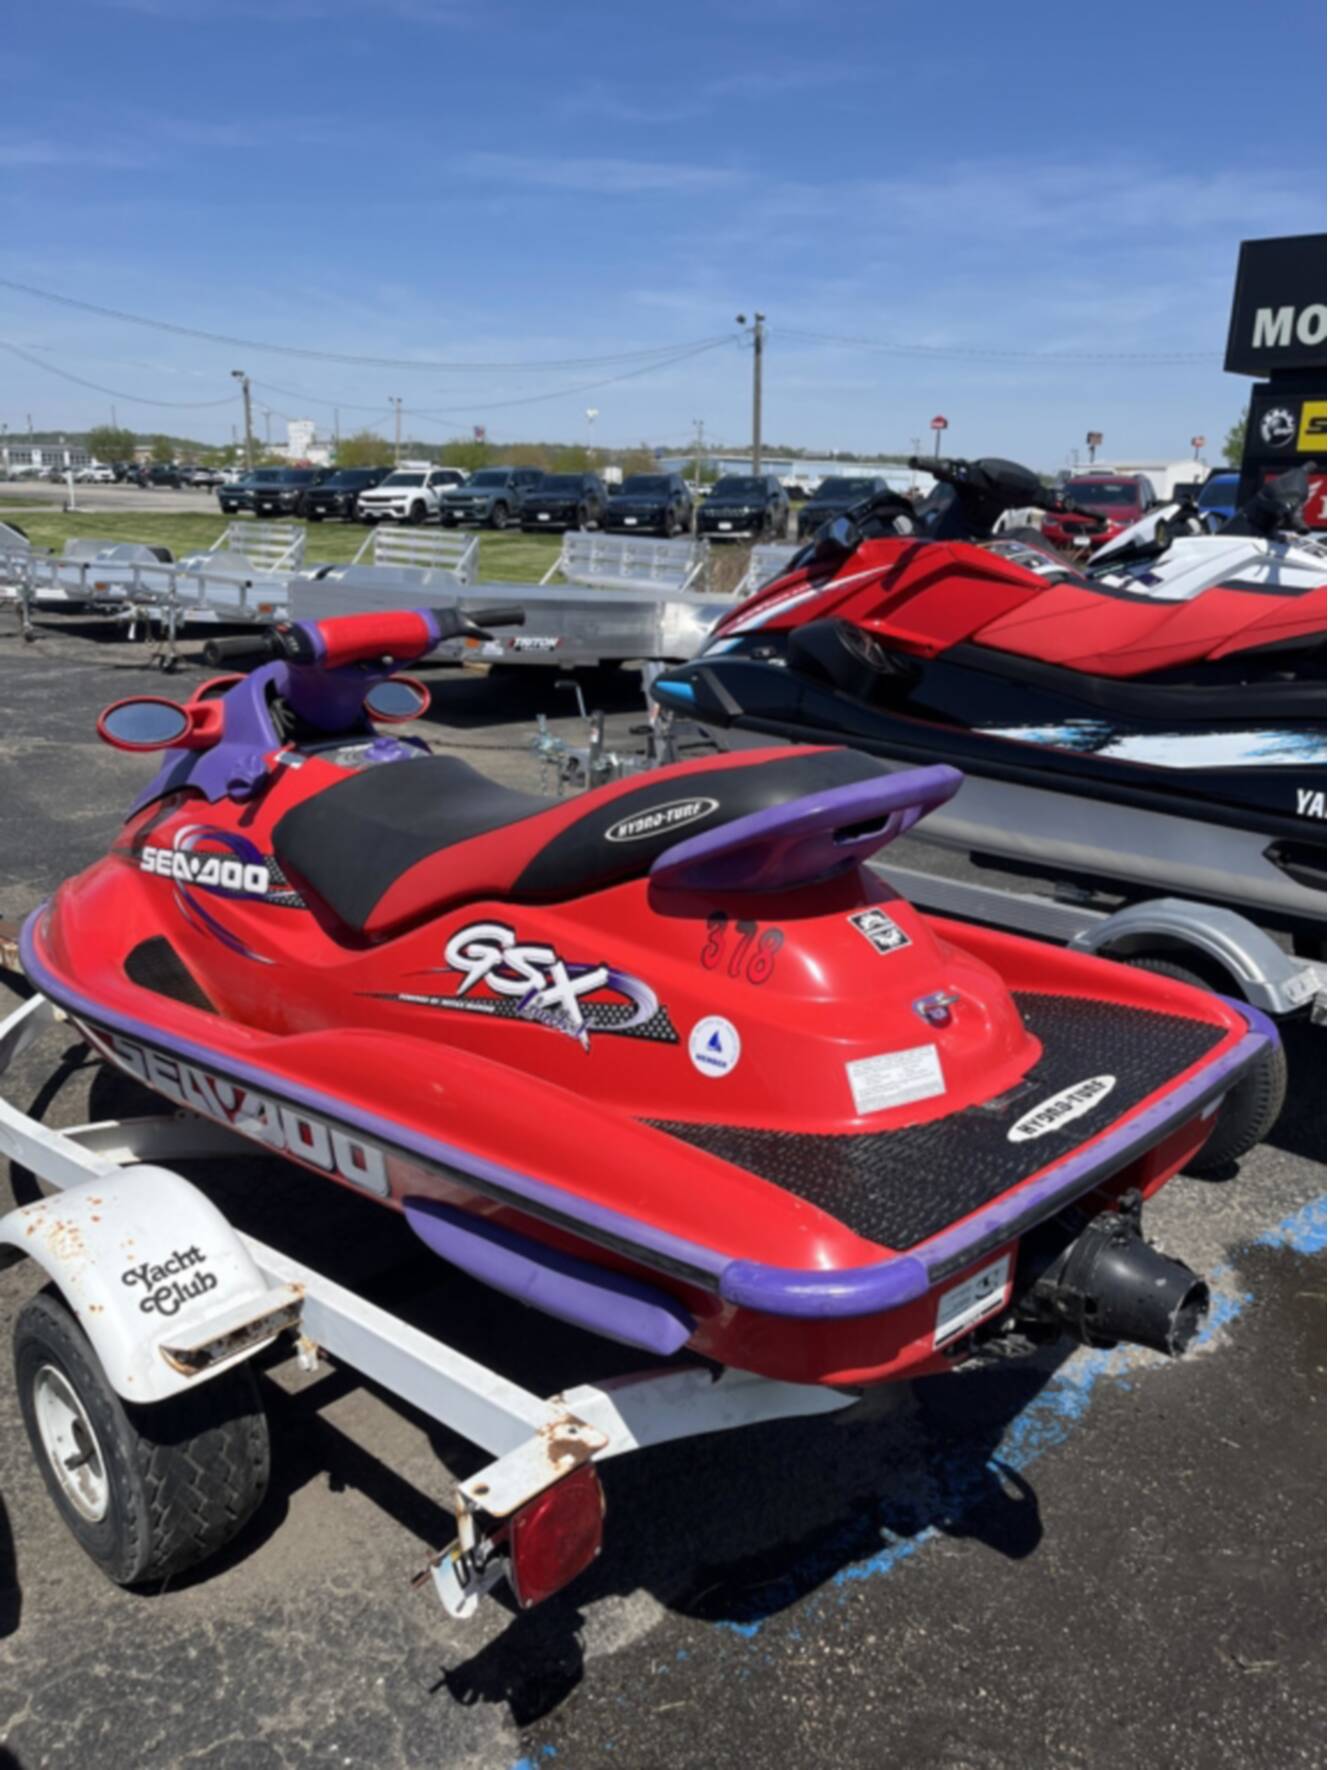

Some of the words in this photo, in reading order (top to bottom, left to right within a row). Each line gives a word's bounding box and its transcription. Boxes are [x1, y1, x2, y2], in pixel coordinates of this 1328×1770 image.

[1252, 304, 1327, 347] MO
[618, 801, 701, 838] HYDRO-TURF
[1297, 788, 1327, 818] YA
[701, 910, 784, 985] 378
[444, 923, 609, 1052] GSX
[121, 1245, 206, 1293] Yacht
[139, 1270, 218, 1316] Club
